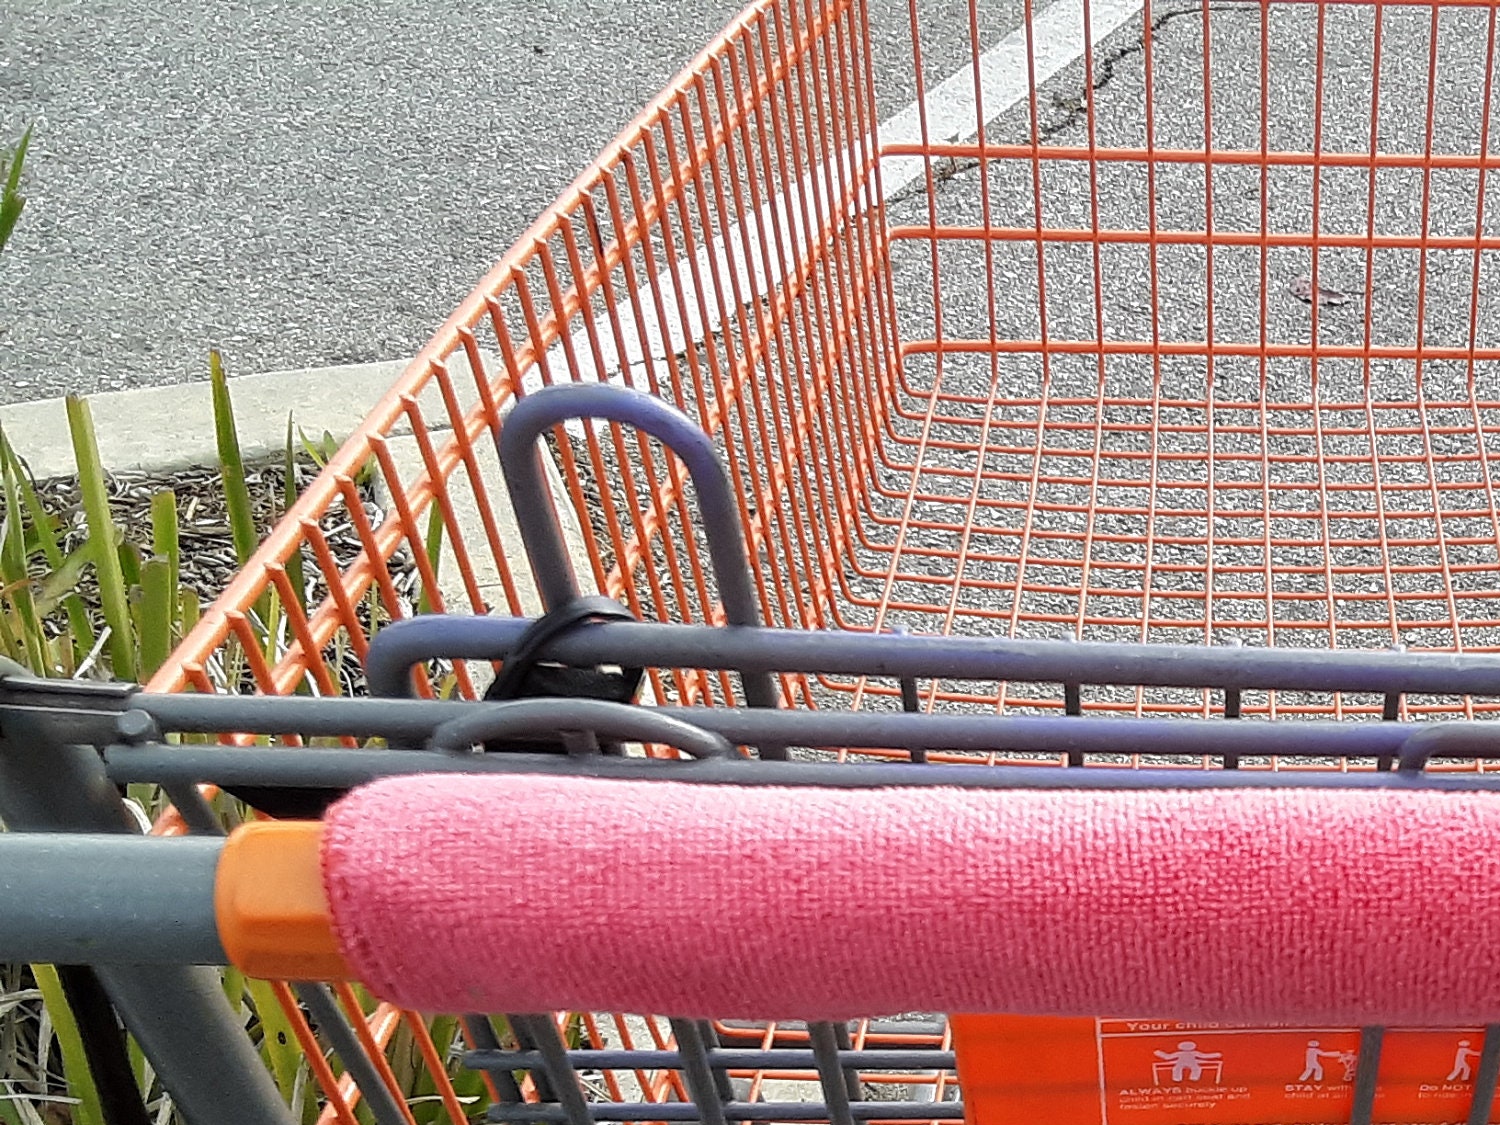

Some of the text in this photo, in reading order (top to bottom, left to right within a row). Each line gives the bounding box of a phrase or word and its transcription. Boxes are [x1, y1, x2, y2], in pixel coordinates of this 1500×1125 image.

[1126, 1022, 1170, 1031] Your
[1119, 1087, 1182, 1096] ALWAYS
[1284, 1084, 1322, 1092] STAY
[1419, 1083, 1473, 1092] Do NOT
